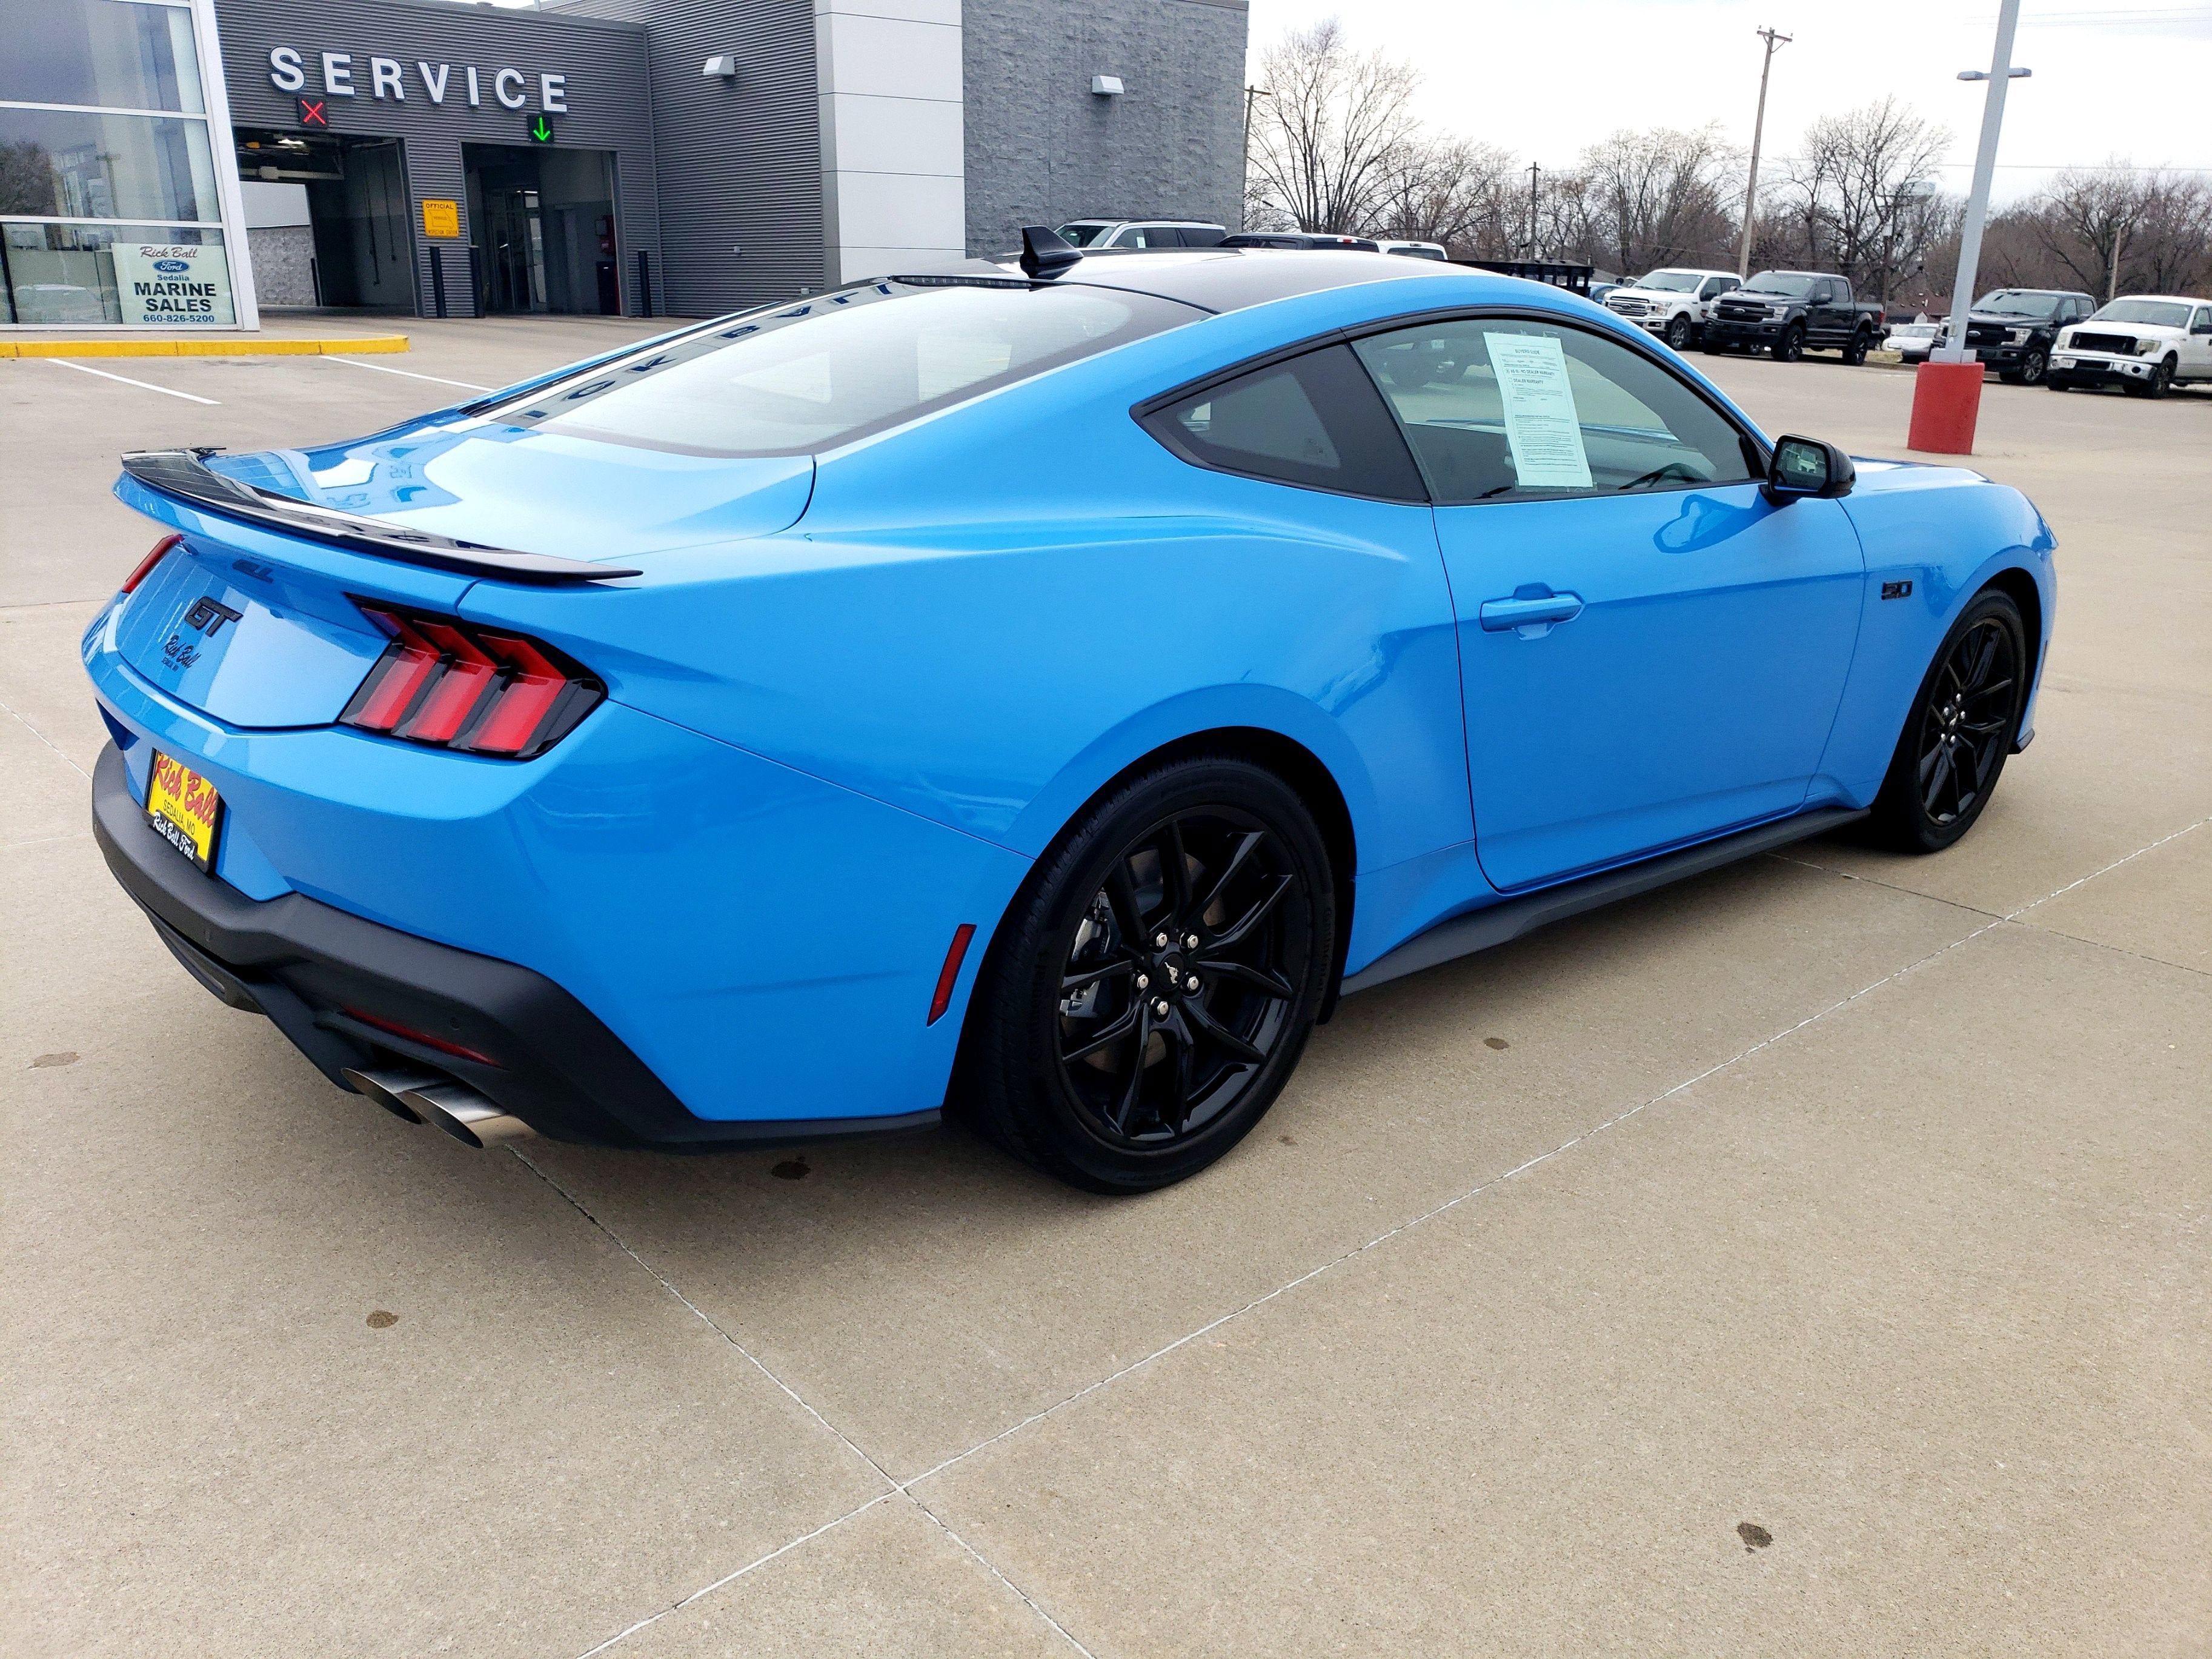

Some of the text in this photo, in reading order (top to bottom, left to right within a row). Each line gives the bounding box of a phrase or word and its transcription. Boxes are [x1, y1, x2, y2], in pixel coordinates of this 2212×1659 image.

[270, 45, 568, 113] SERVICE
[140, 246, 198, 259] Rick Ball
[160, 261, 182, 271] Ford
[135, 282, 217, 297] MARINE
[145, 298, 212, 312] SALES
[143, 314, 214, 323] 660-826-5200
[184, 596, 244, 638] GT
[153, 751, 219, 828] Rick Ball
[187, 819, 195, 836] MO
[153, 811, 194, 861] Rick Ball Ford
